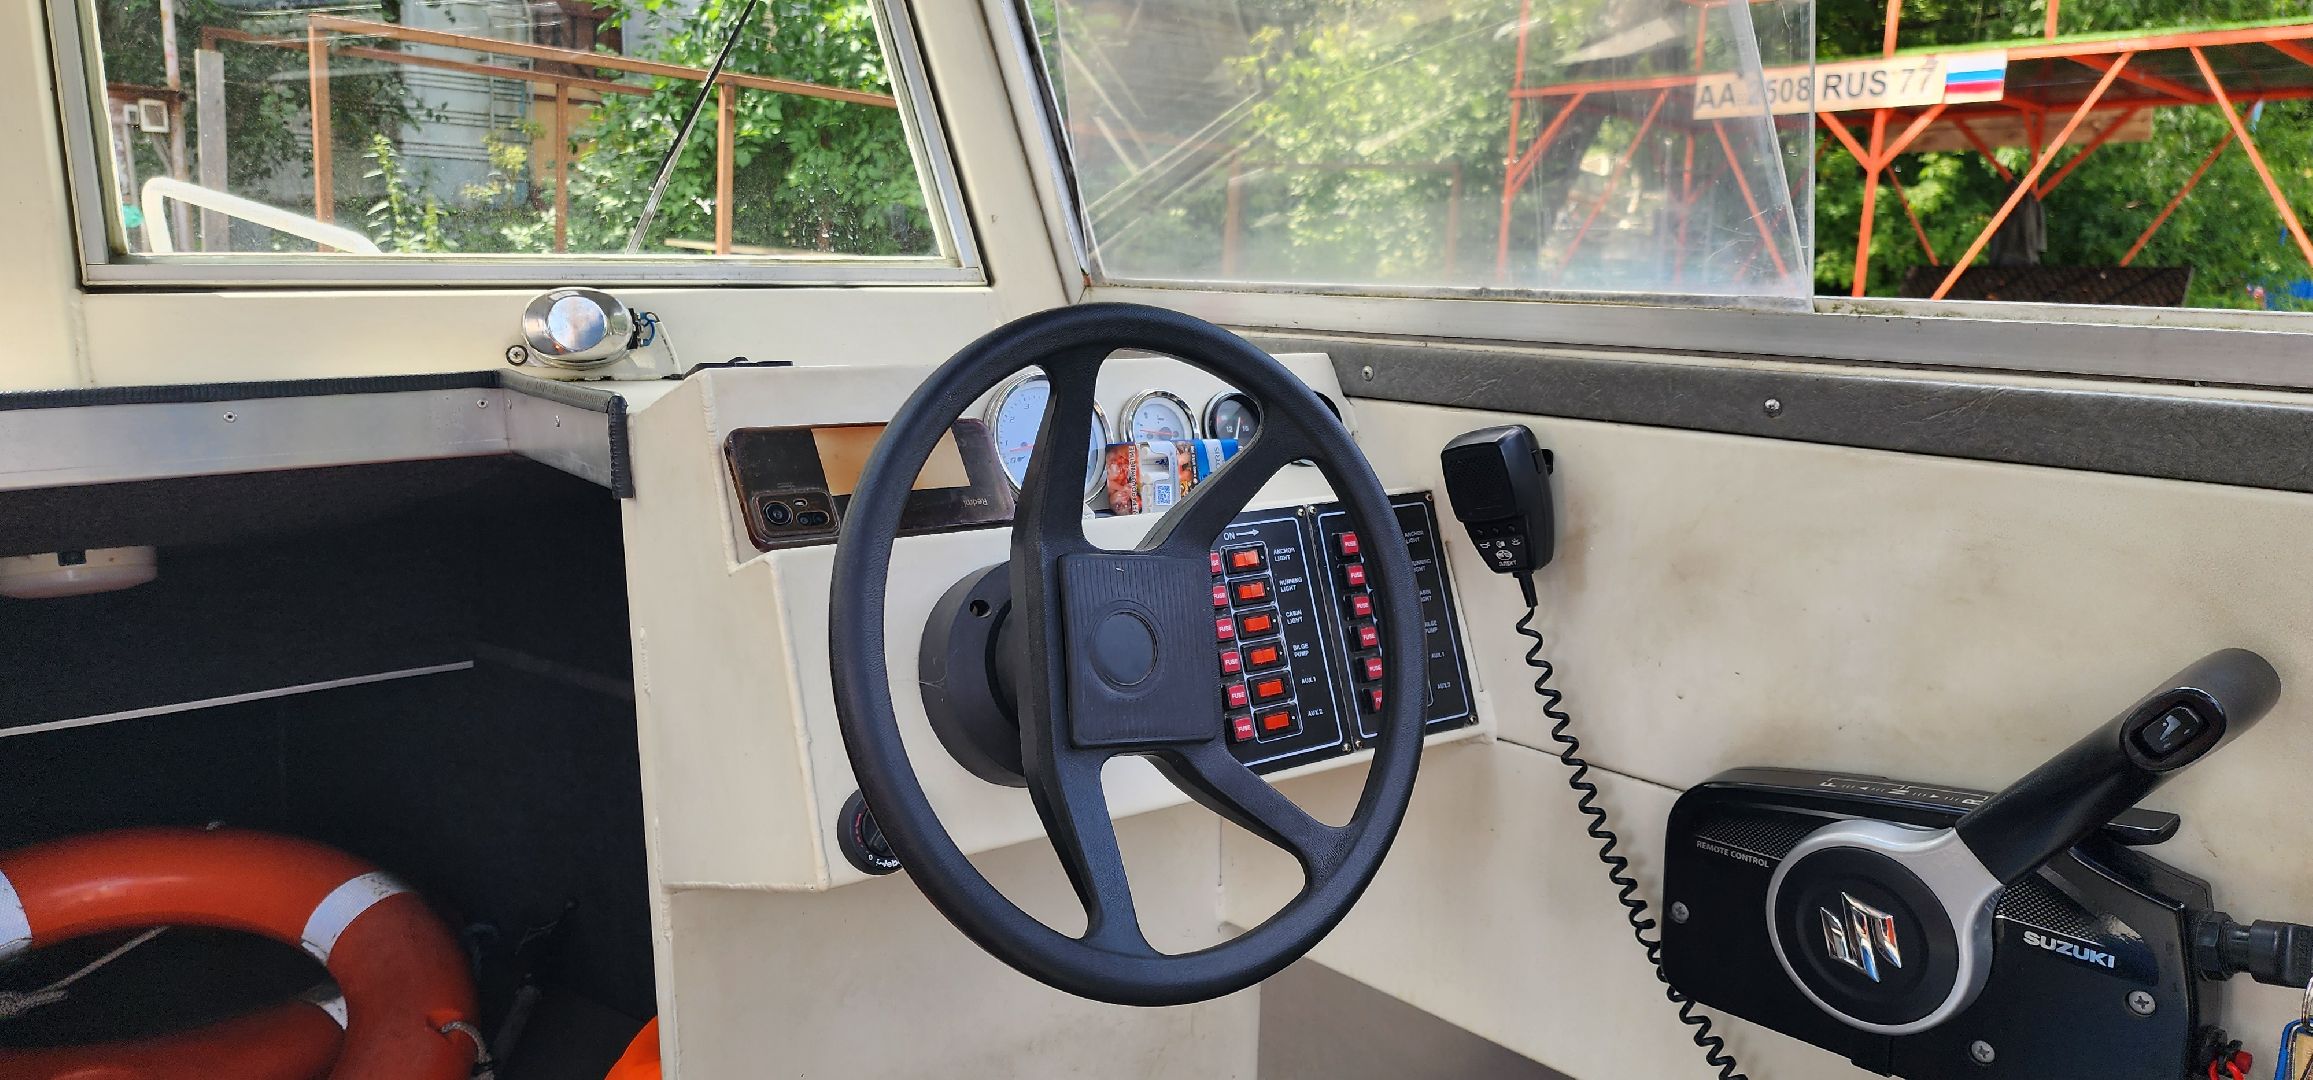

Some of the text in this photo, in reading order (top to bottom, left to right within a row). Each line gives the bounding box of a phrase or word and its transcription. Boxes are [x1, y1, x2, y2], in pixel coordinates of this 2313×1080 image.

[1699, 83, 1735, 109] AA
[1824, 70, 1888, 98] RUS
[1901, 67, 1937, 94] 77
[962, 498, 988, 507] Redmi
[1223, 532, 1236, 541] ON
[1280, 585, 1297, 593] LIGHT
[1286, 616, 1303, 625] LIGHT
[1225, 658, 1239, 666] FUSE
[1368, 664, 1382, 672] FUSE
[1237, 724, 1251, 732] FUSE
[1820, 780, 1837, 788] F
[1962, 798, 1985, 806] R
[1696, 840, 1770, 869] REMOTE CONTROL
[2023, 930, 2116, 969] SUZUKI
